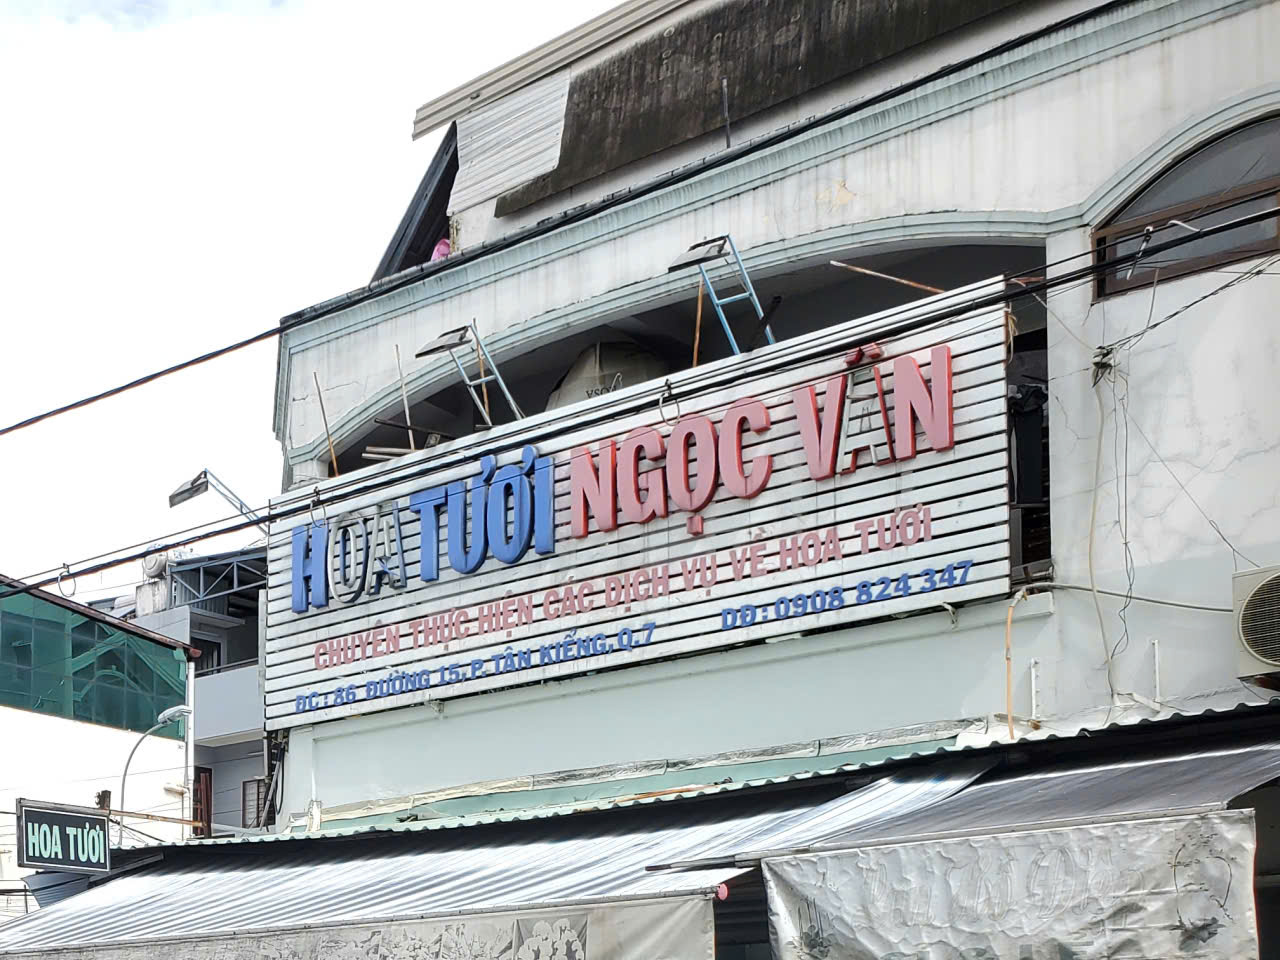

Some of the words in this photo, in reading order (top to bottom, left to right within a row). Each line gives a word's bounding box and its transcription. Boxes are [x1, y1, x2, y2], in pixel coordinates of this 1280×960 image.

[291, 502, 407, 614] HOA
[409, 445, 555, 582] TƯƠI
[570, 397, 773, 538] NGỌC
[314, 619, 401, 670] CHUYÊN
[409, 606, 470, 651] THỰC
[478, 590, 533, 638] HIỆN
[542, 575, 594, 620] CÁC
[605, 565, 670, 613] DỊCH
[681, 554, 718, 596] VỤ
[729, 530, 768, 581] VỀ
[779, 527, 843, 568] HOA
[855, 503, 933, 553] TƯƠI
[774, 587, 844, 619] 0908
[855, 576, 911, 604] 824
[919, 560, 974, 593] 347
[333, 682, 356, 706] 86
[365, 663, 431, 699] ĐƯỜNG
[491, 646, 531, 675] TÂN
[617, 622, 656, 650] Q.7
[27, 822, 62, 859] HOA
[66, 822, 105, 864] TƯƠI
